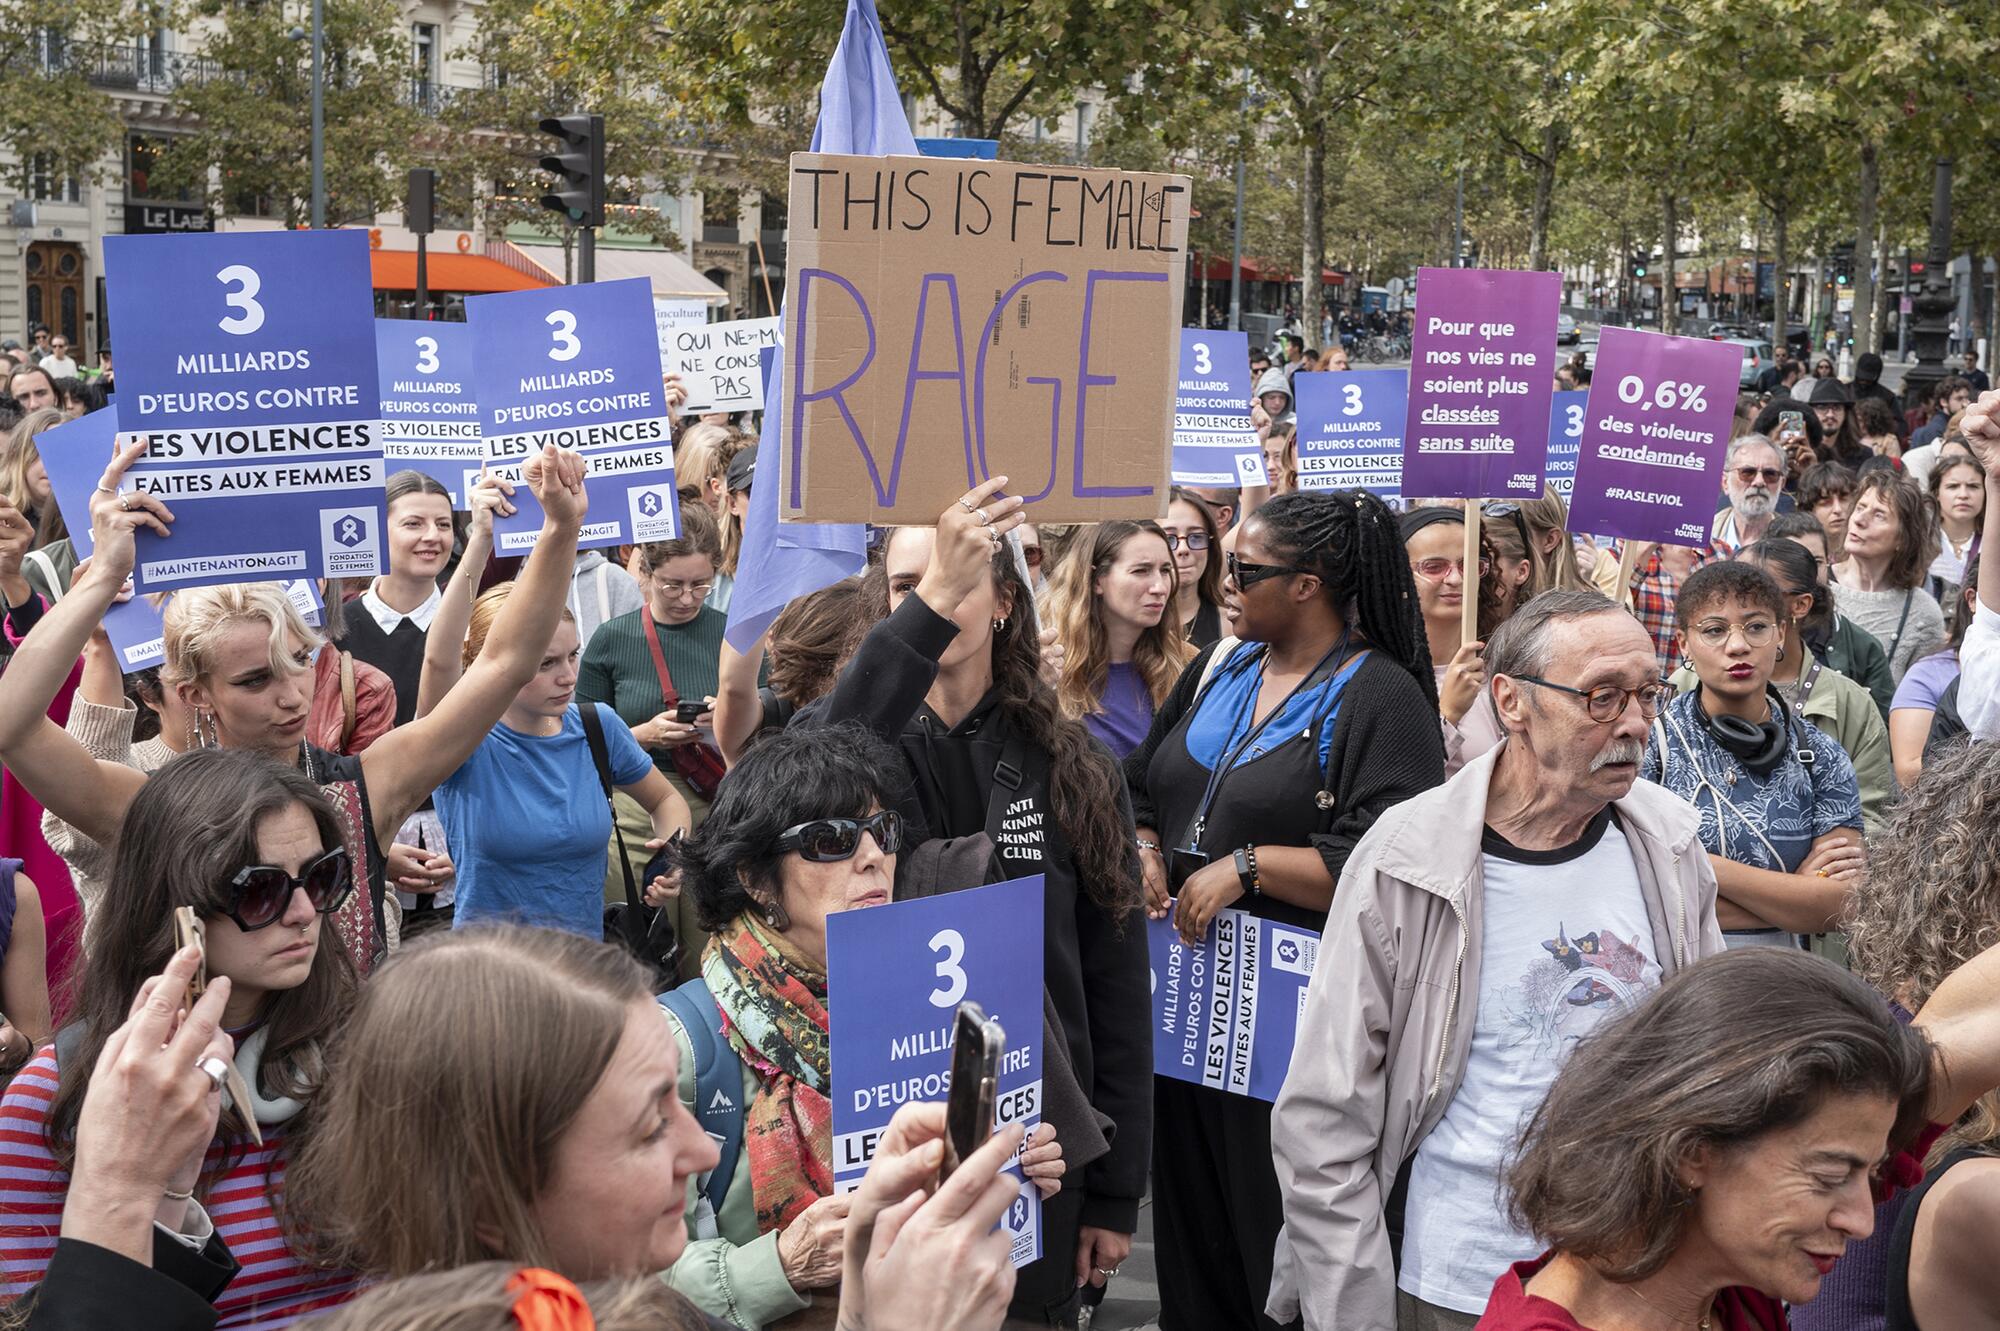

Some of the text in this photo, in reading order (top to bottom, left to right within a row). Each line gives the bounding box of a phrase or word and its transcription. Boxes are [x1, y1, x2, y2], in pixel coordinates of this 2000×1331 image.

[143, 207, 167, 228] LE
[795, 168, 1184, 252] THIS IS FEMALE
[216, 264, 265, 335] 3
[544, 309, 582, 362] 3
[677, 332, 711, 352] QUI
[725, 330, 748, 346] NE
[760, 328, 778, 344] M
[1428, 317, 1515, 341] Pour que
[177, 350, 310, 374] MILLIARDS
[415, 336, 440, 374] 3
[681, 359, 704, 372] NE
[1192, 343, 1212, 375] 3
[1426, 347, 1537, 366] nos vies ne
[393, 381, 462, 394] MILLIARDS
[520, 368, 615, 393] MILLIARDS
[710, 375, 751, 396] PAS
[790, 267, 1169, 510] RAGE
[1179, 381, 1229, 392] MILLIARDS
[1423, 375, 1529, 398] soient plus
[255, 385, 359, 409] CONTRE
[576, 392, 651, 415] CONTRE
[1175, 397, 1247, 410] EUROS CONTRE
[1341, 384, 1364, 416] 3
[1617, 375, 1708, 413] 0,6%
[380, 401, 477, 415] ’EUROS CONTR
[1421, 403, 1500, 422] classées
[381, 422, 481, 437] ES VIOLENCE
[1184, 416, 1251, 429] VIOLENCES
[1323, 421, 1382, 434] MILLIARDS
[1564, 404, 1584, 437] 3
[1599, 415, 1714, 445] des violeurs
[191, 424, 371, 455] VIOLENCES
[490, 421, 661, 457] LES VIOLENCES
[1173, 434, 1254, 445] ITES AUX FEMMES
[1357, 438, 1400, 449] CONTRE
[1418, 433, 1515, 451] sans suite
[1547, 444, 1580, 454] MILLIA
[383, 444, 483, 457] ITES AUX FEMME
[1598, 441, 1705, 469] condamnés
[496, 466, 522, 482] FAI
[594, 452, 664, 473] FEMMES
[1303, 456, 1404, 470] LES VIOLENCES
[1545, 461, 1574, 471] UROS
[135, 465, 372, 495] FAITES AUX FEMMES
[1304, 476, 1338, 487] FAITES
[1340, 475, 1362, 486] AUX
[1507, 480, 1537, 489] toutes
[1513, 473, 1537, 482] nous
[1605, 487, 1683, 507] #RASLEVIOL
[636, 521, 669, 530] FONDATION
[1674, 529, 1704, 539] toutes
[1681, 523, 1704, 533] nous
[148, 555, 299, 577] #MAINTENANTONAGIT
[329, 553, 374, 561] FONDATION
[1002, 813, 1044, 830] KINNY
[1003, 847, 1042, 860] CLUB
[928, 928, 968, 1009] 3
[1190, 939, 1206, 989] CONT
[1162, 943, 1182, 1034] MILLIARDS
[1206, 918, 1233, 1081] LES VIOLENCES
[1233, 925, 1256, 1086] FAITES AUX FEMMES
[1000, 1046, 1031, 1078] TRE
[845, 1131, 885, 1165] LE
